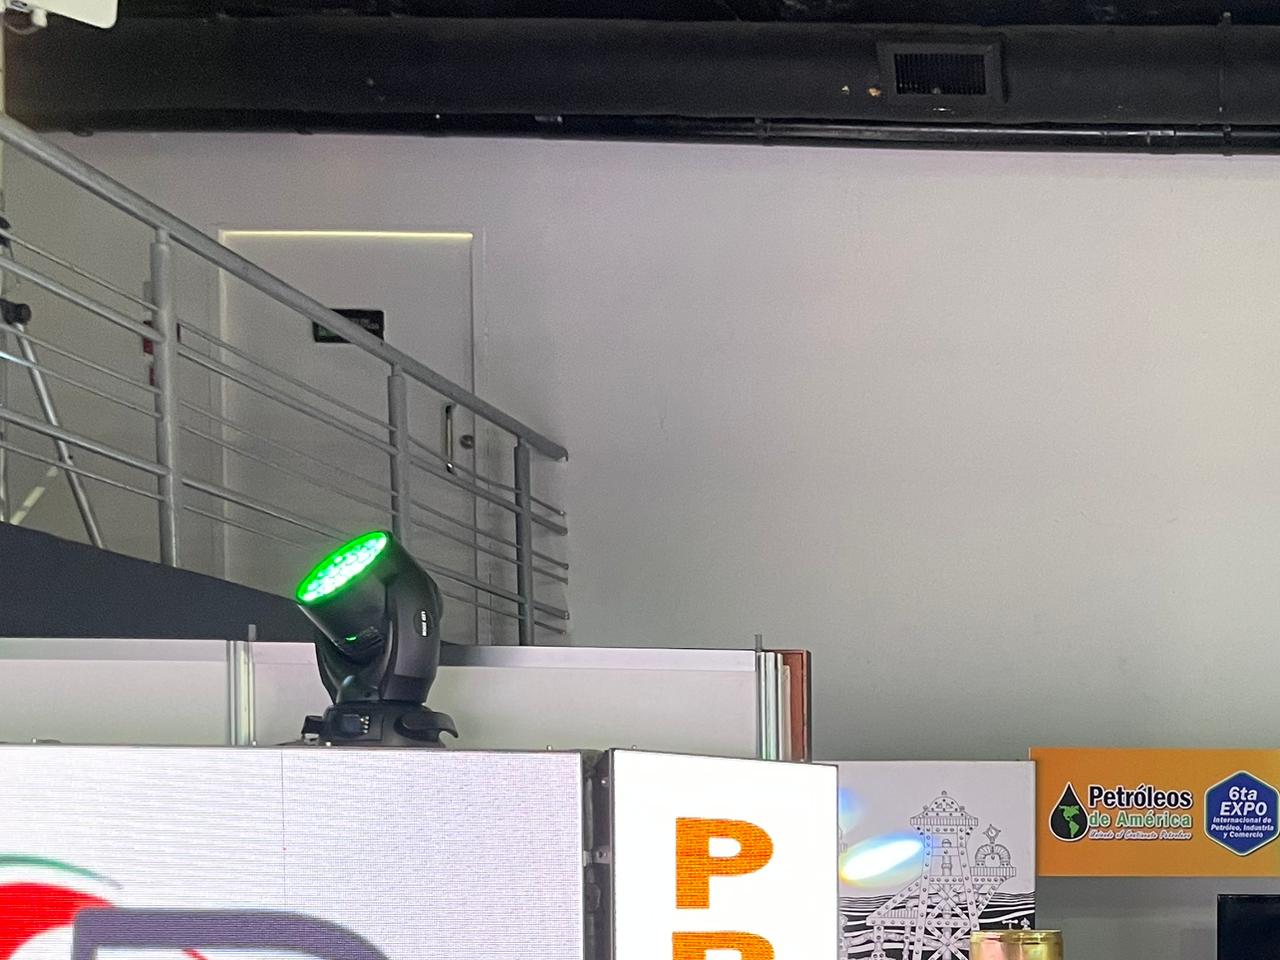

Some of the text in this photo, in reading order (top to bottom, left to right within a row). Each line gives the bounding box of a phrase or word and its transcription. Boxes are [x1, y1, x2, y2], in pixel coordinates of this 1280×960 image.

[1089, 785, 1192, 808] Petróleos
[1229, 786, 1258, 801] 6ta
[1220, 802, 1268, 816] EXPO
[1089, 811, 1191, 828] de América
